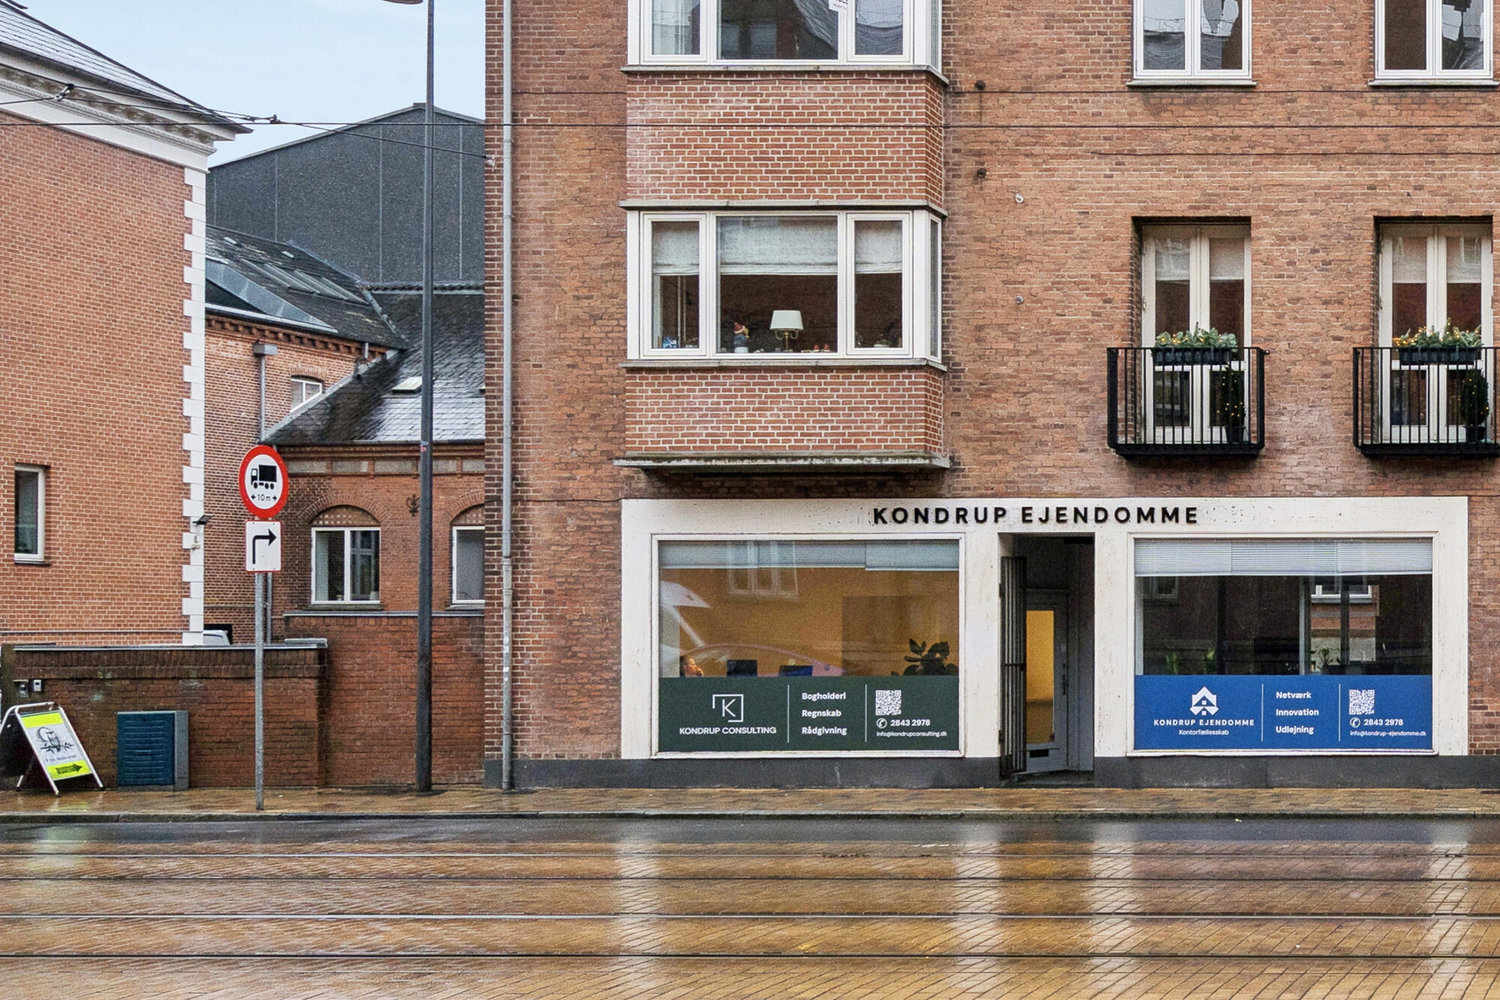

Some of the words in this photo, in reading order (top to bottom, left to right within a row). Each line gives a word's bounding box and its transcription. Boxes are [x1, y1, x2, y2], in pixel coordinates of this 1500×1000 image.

[257, 493, 265, 502] 10
[873, 506, 1007, 525] KONDRUP
[1021, 506, 1199, 524] EJENDOMME
[801, 691, 847, 702] Bogholderi
[1276, 691, 1312, 699] Netværk
[801, 709, 842, 719] Regnskab
[1275, 708, 1320, 716] Innovation
[890, 719, 910, 727] 2843
[911, 718, 931, 726] 2978
[1363, 718, 1383, 726] 2843
[1384, 718, 1404, 726] 2978
[679, 727, 721, 735] KONDRUP
[722, 726, 777, 735] CONSULTING
[801, 725, 848, 736] Rådgivning
[876, 730, 948, 738] info@kondrupconsulting.dk
[1178, 728, 1230, 736] Kontorfællesskab
[1275, 725, 1315, 735] Udlejning
